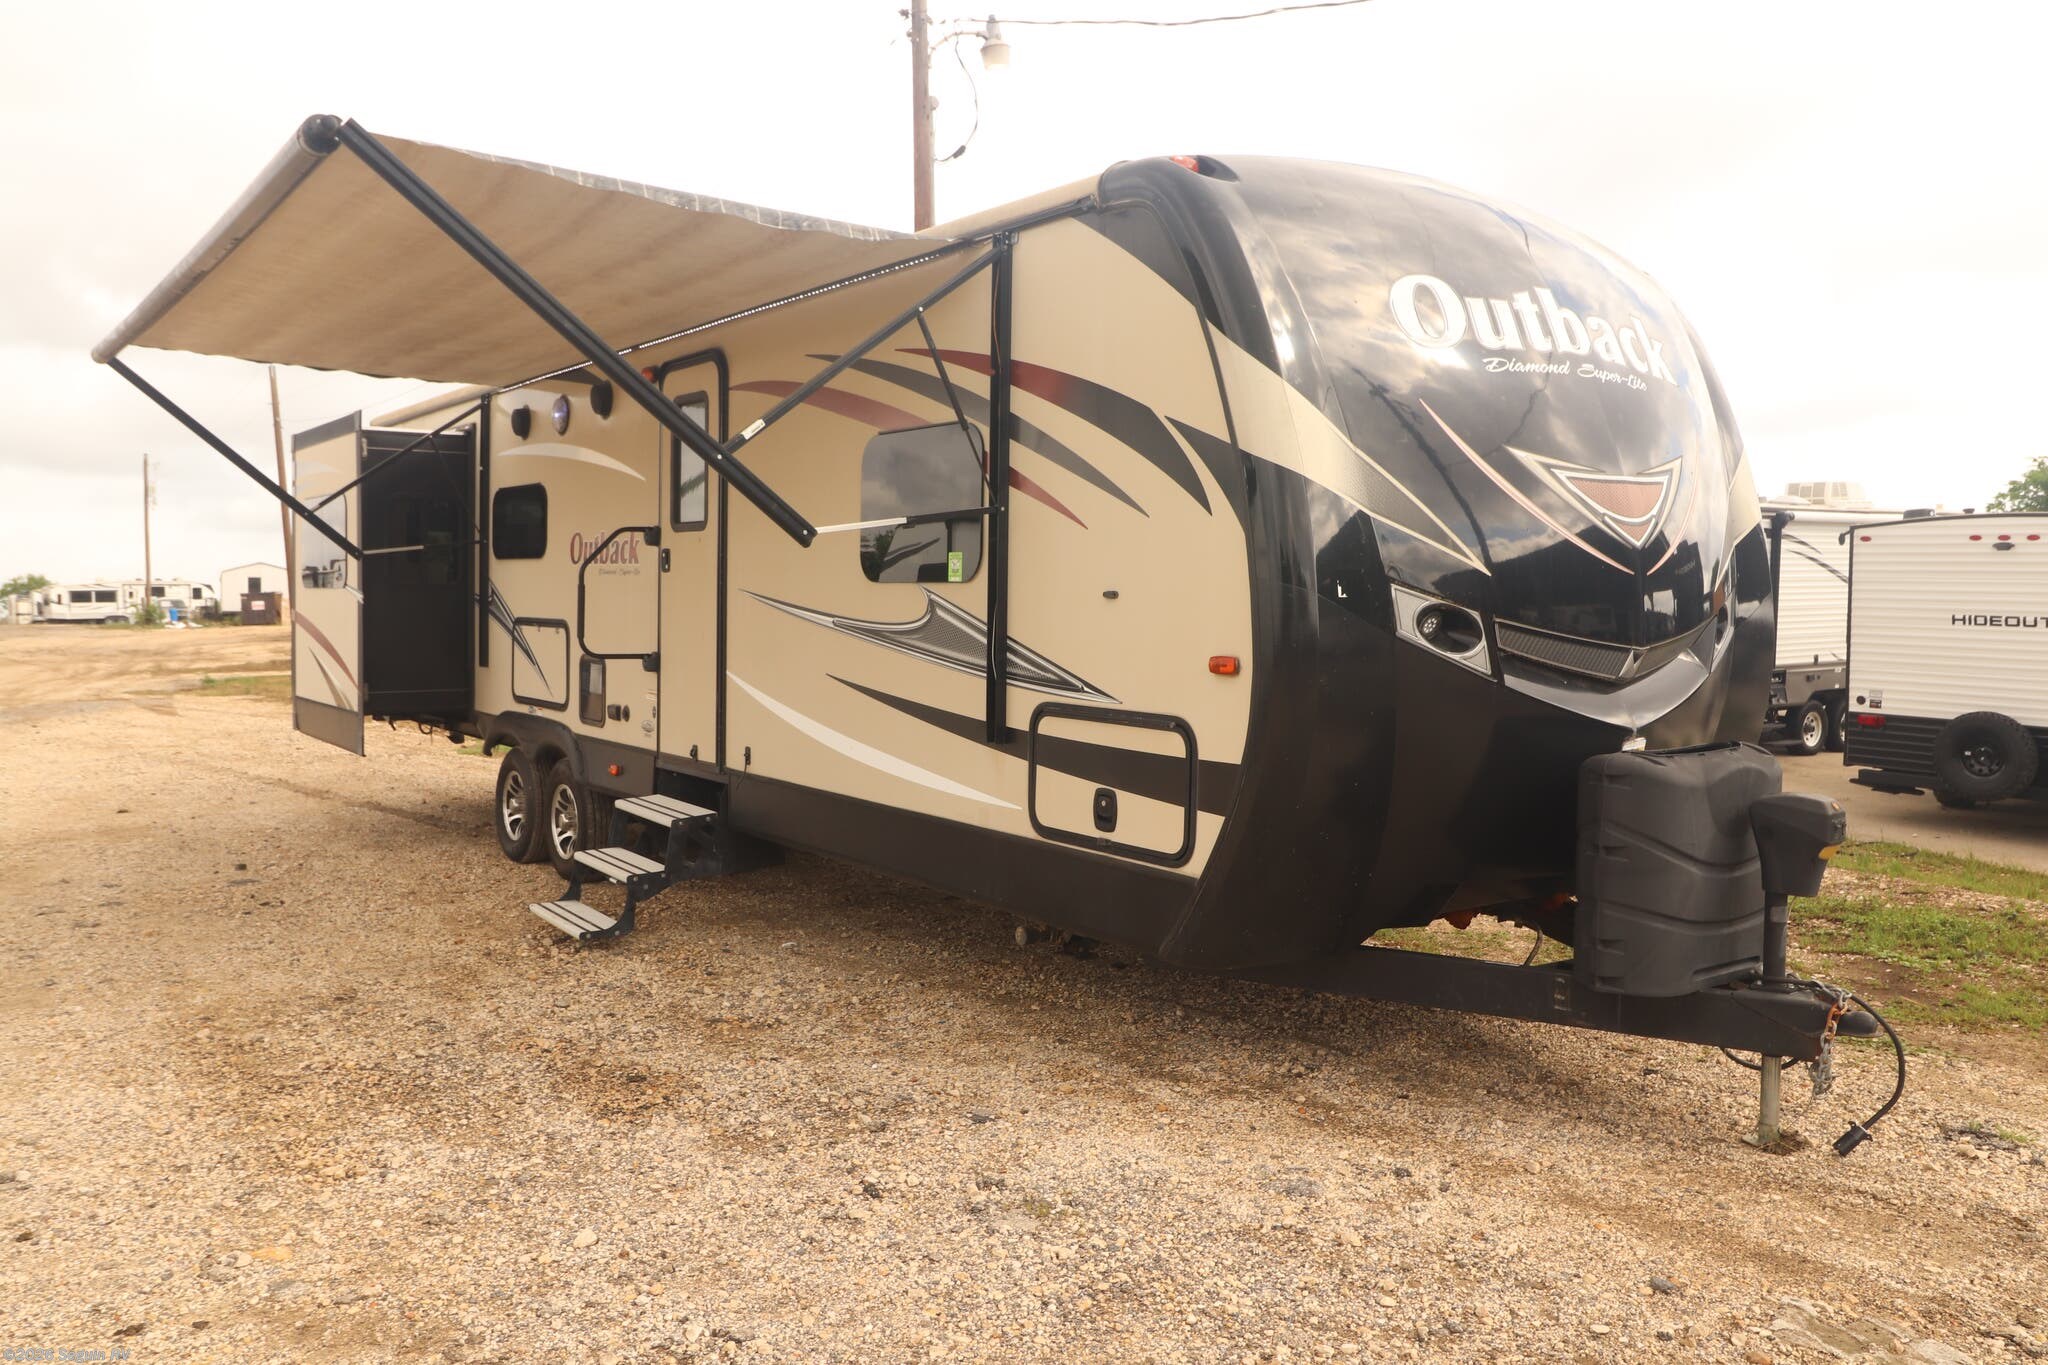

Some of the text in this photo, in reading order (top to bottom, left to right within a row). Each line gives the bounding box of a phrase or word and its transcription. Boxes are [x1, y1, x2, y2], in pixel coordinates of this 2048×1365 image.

[1390, 274, 1678, 386] Outback
[1482, 357, 1648, 391] Diamond Super-Lite
[569, 532, 640, 564] Outback
